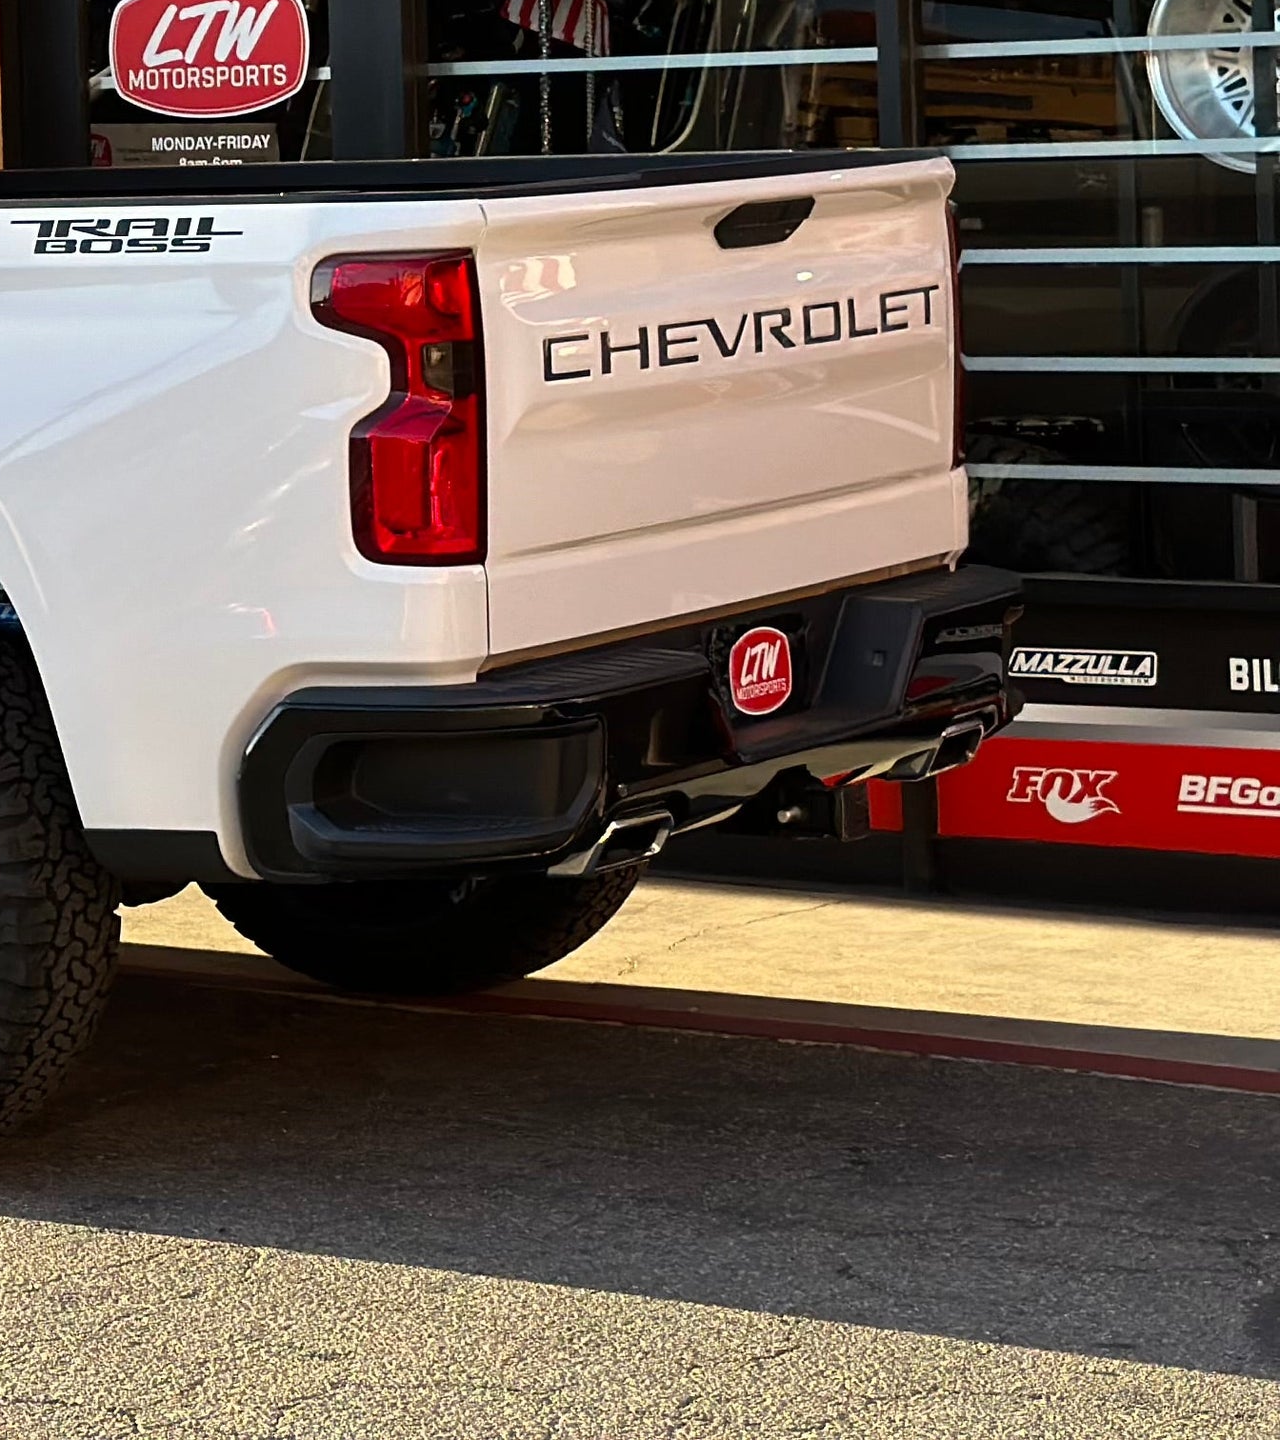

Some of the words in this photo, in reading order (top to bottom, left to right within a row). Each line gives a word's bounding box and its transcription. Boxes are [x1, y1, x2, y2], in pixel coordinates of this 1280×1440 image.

[128, 64, 287, 91] MOTORSPORTS
[151, 135, 271, 152] MONDAY-FRIDAY
[10, 217, 243, 238] TRAIL
[33, 237, 212, 254] BOSS
[543, 284, 940, 382] CHEVROLET
[741, 640, 781, 687] LTW
[1012, 653, 1152, 677] MAZZULLA
[737, 678, 787, 700] MOTORSPORTS
[1006, 766, 1119, 802] FOX
